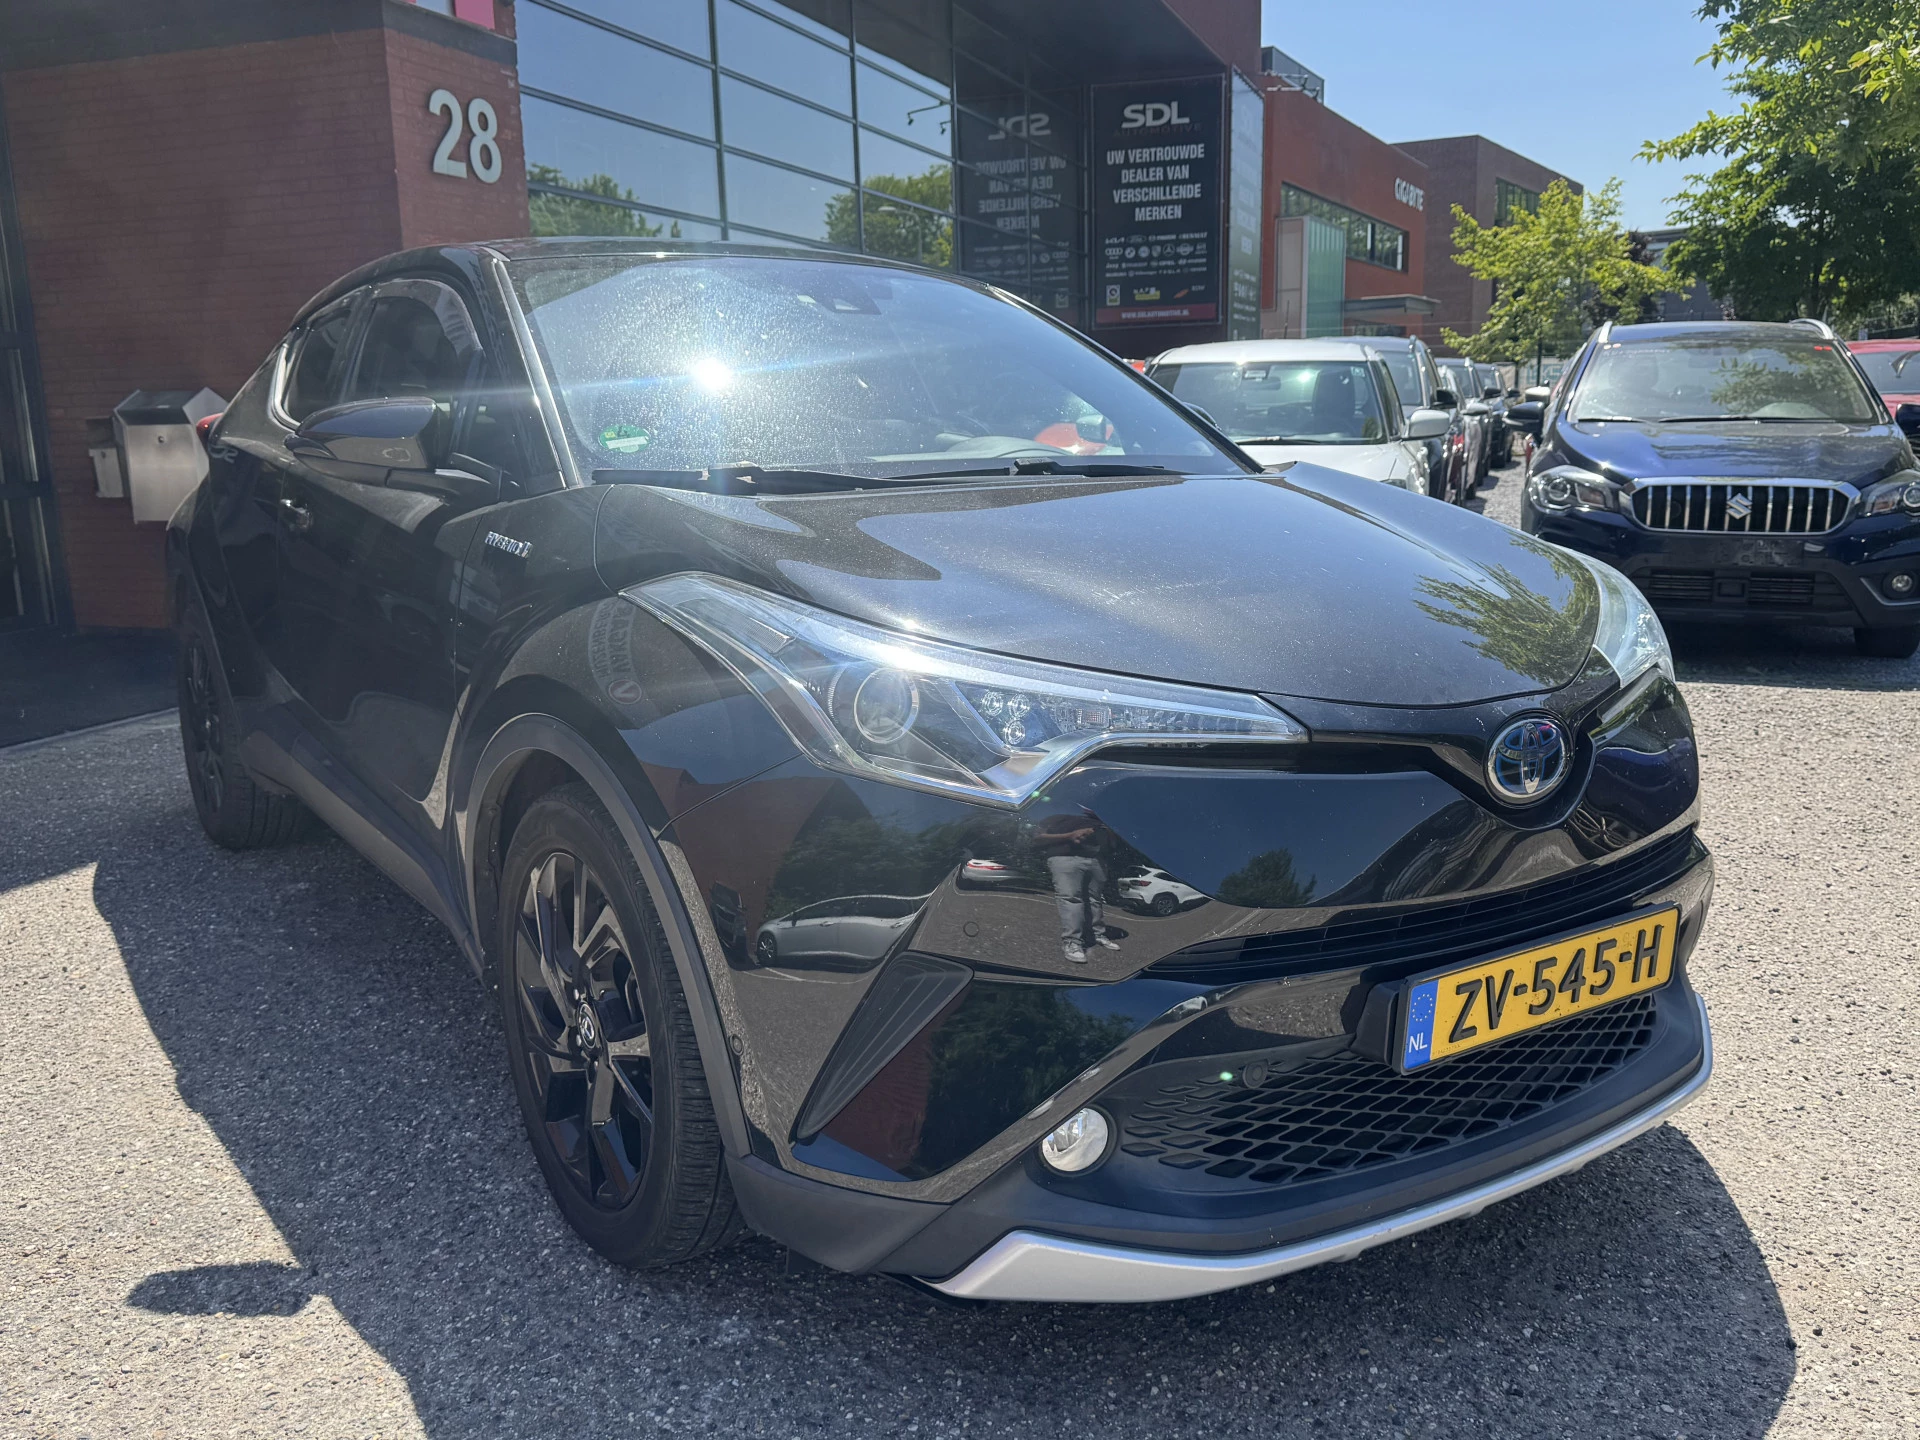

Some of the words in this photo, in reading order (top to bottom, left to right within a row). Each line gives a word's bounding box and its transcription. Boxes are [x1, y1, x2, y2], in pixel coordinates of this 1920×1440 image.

[1120, 101, 1191, 129] SDL
[427, 87, 503, 184] 28
[1106, 149, 1126, 165] UW
[1128, 143, 1205, 164] VERTROUWDE
[1121, 167, 1164, 184] DEALER
[1167, 164, 1190, 180] VAN
[1113, 183, 1202, 204] VERSCHILLENDE
[1134, 204, 1182, 222] MERKEN
[1448, 923, 1665, 1044] ZV-545-H
[1407, 1031, 1429, 1054] NL
